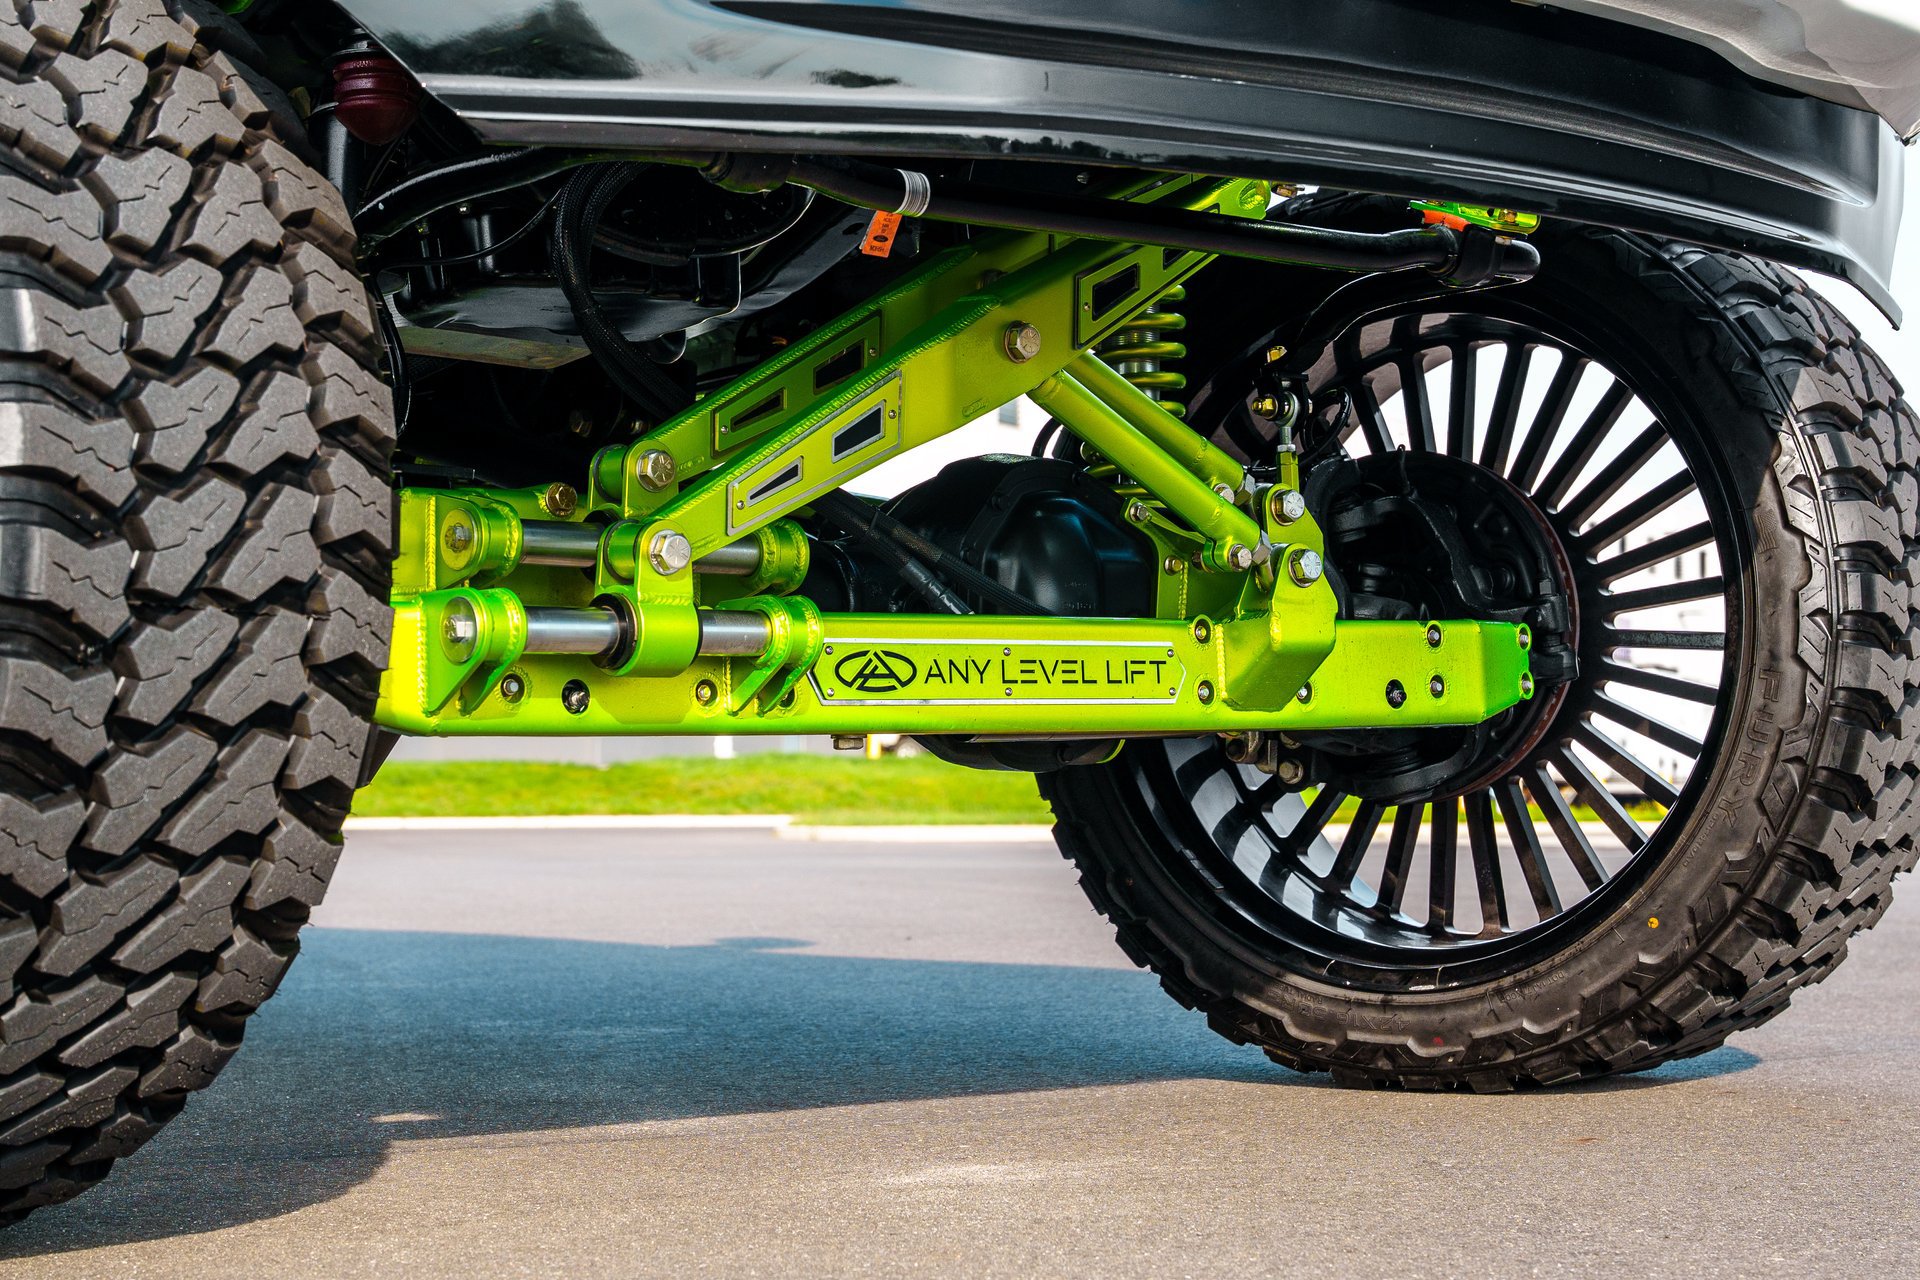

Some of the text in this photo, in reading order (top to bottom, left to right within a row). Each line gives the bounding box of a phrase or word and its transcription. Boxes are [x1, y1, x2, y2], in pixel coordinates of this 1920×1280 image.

[924, 658, 1167, 685] ANY LEVEL LIFT
[1717, 667, 1783, 828] FURY
